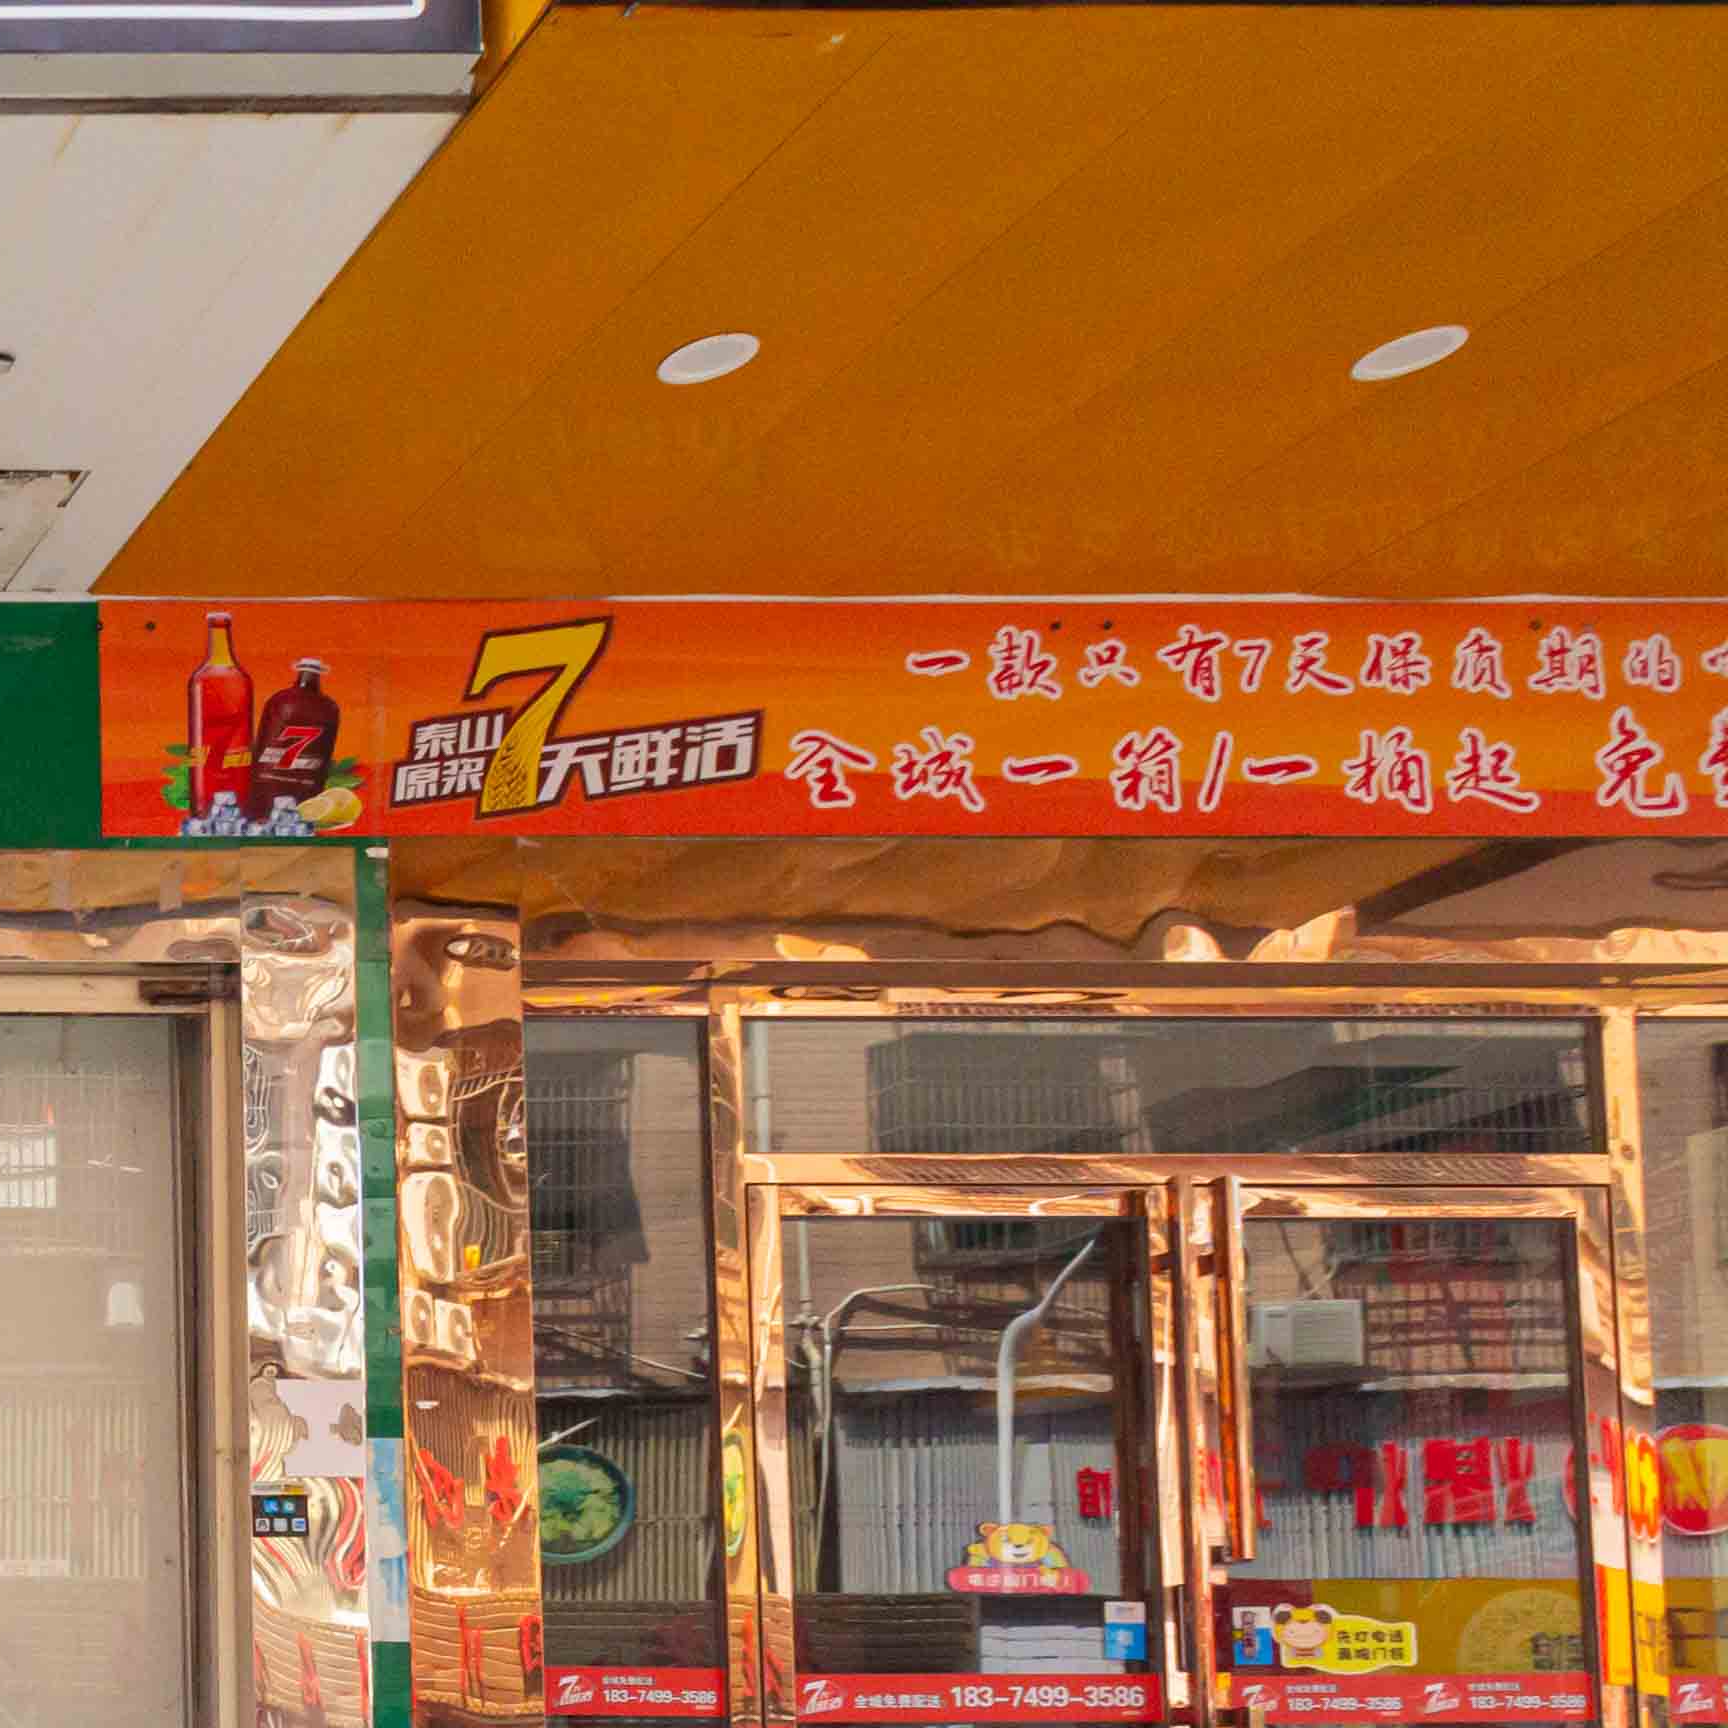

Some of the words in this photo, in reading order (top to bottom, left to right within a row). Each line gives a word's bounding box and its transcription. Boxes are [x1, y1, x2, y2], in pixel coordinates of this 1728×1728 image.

[413, 713, 504, 763] 泰山
[393, 756, 487, 802] 原浆
[603, 1689, 717, 1704] 183-7499-3586
[950, 1686, 1145, 1708] 183-7499-3586
